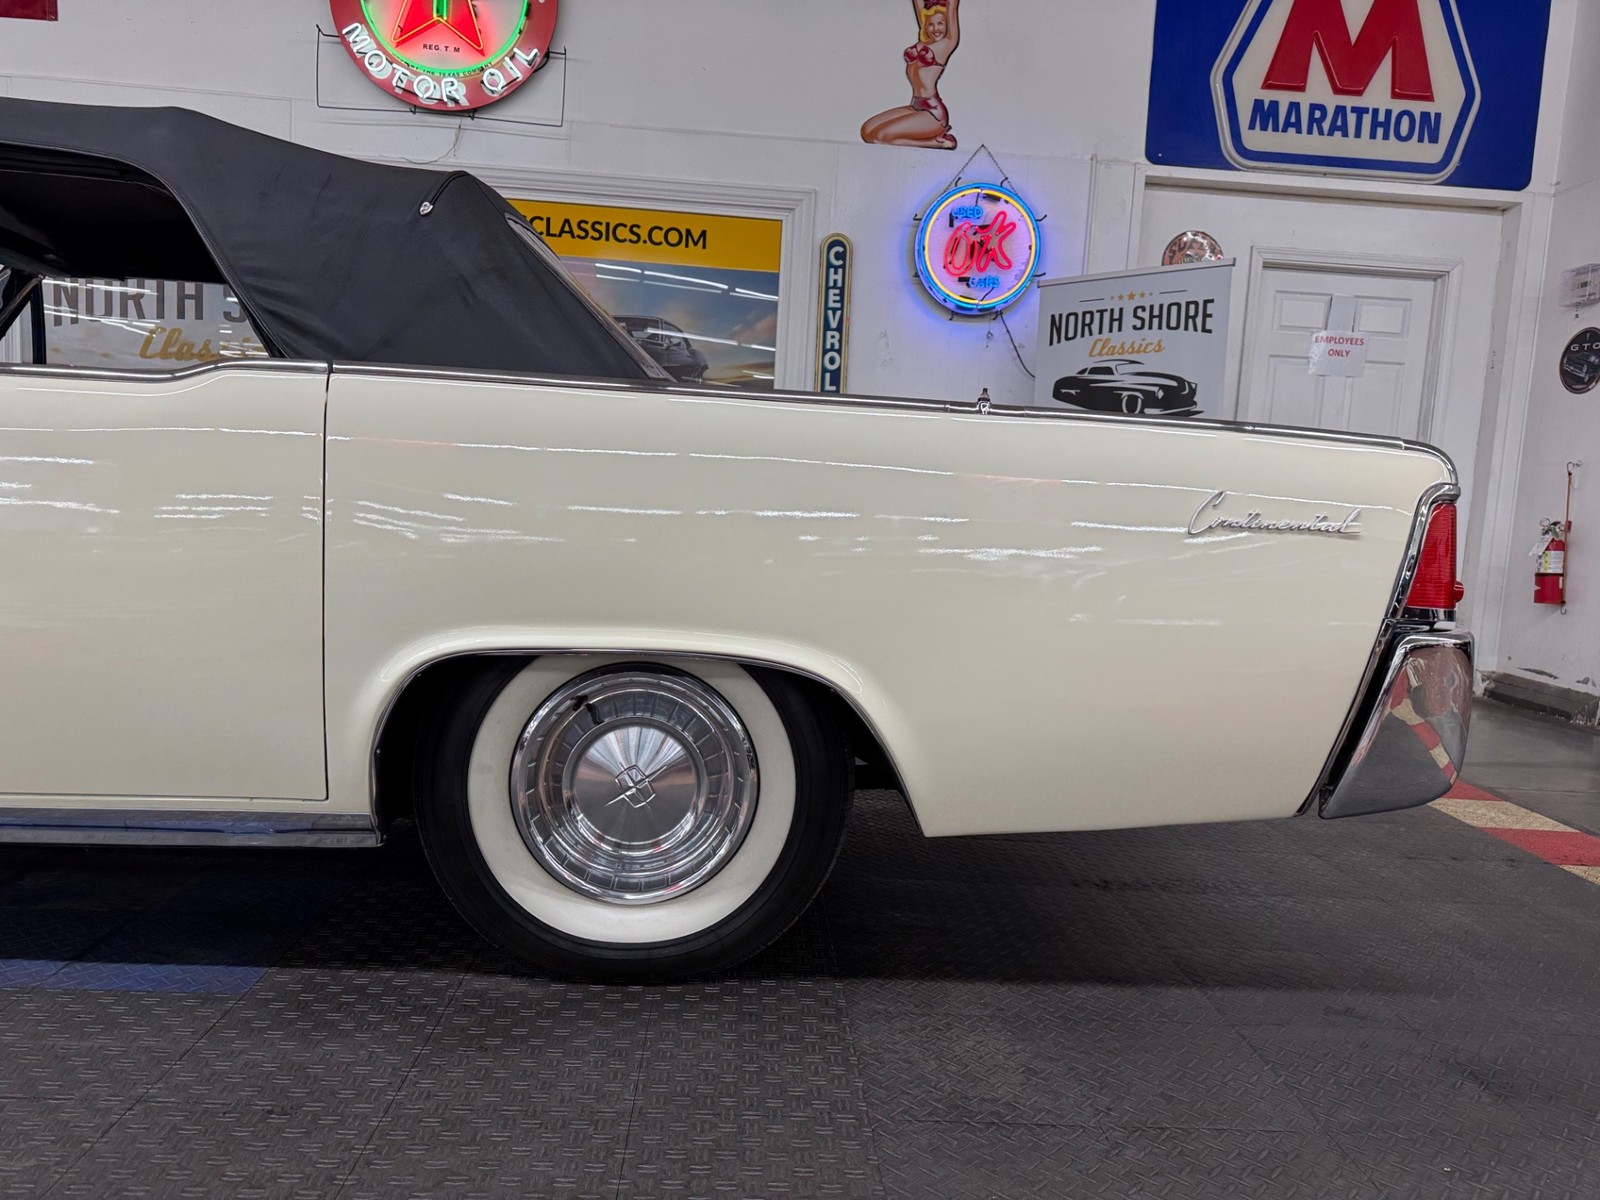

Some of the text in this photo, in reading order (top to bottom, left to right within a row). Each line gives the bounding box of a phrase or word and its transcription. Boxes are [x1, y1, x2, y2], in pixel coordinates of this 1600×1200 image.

[341, 22, 539, 107] MOTOR OIL
[1248, 98, 1442, 144] MARATHON
[951, 204, 984, 218] USED
[527, 214, 708, 250] CLASSICS.COM
[968, 275, 1001, 288] CARS
[1049, 298, 1215, 347] NORTH SHORE
[1088, 336, 1166, 358] Classics
[1314, 335, 1365, 346] EMPLOYEES
[1570, 341, 1600, 352] GTO
[1327, 348, 1351, 358] ONLY
[1187, 490, 1362, 536] Continental
